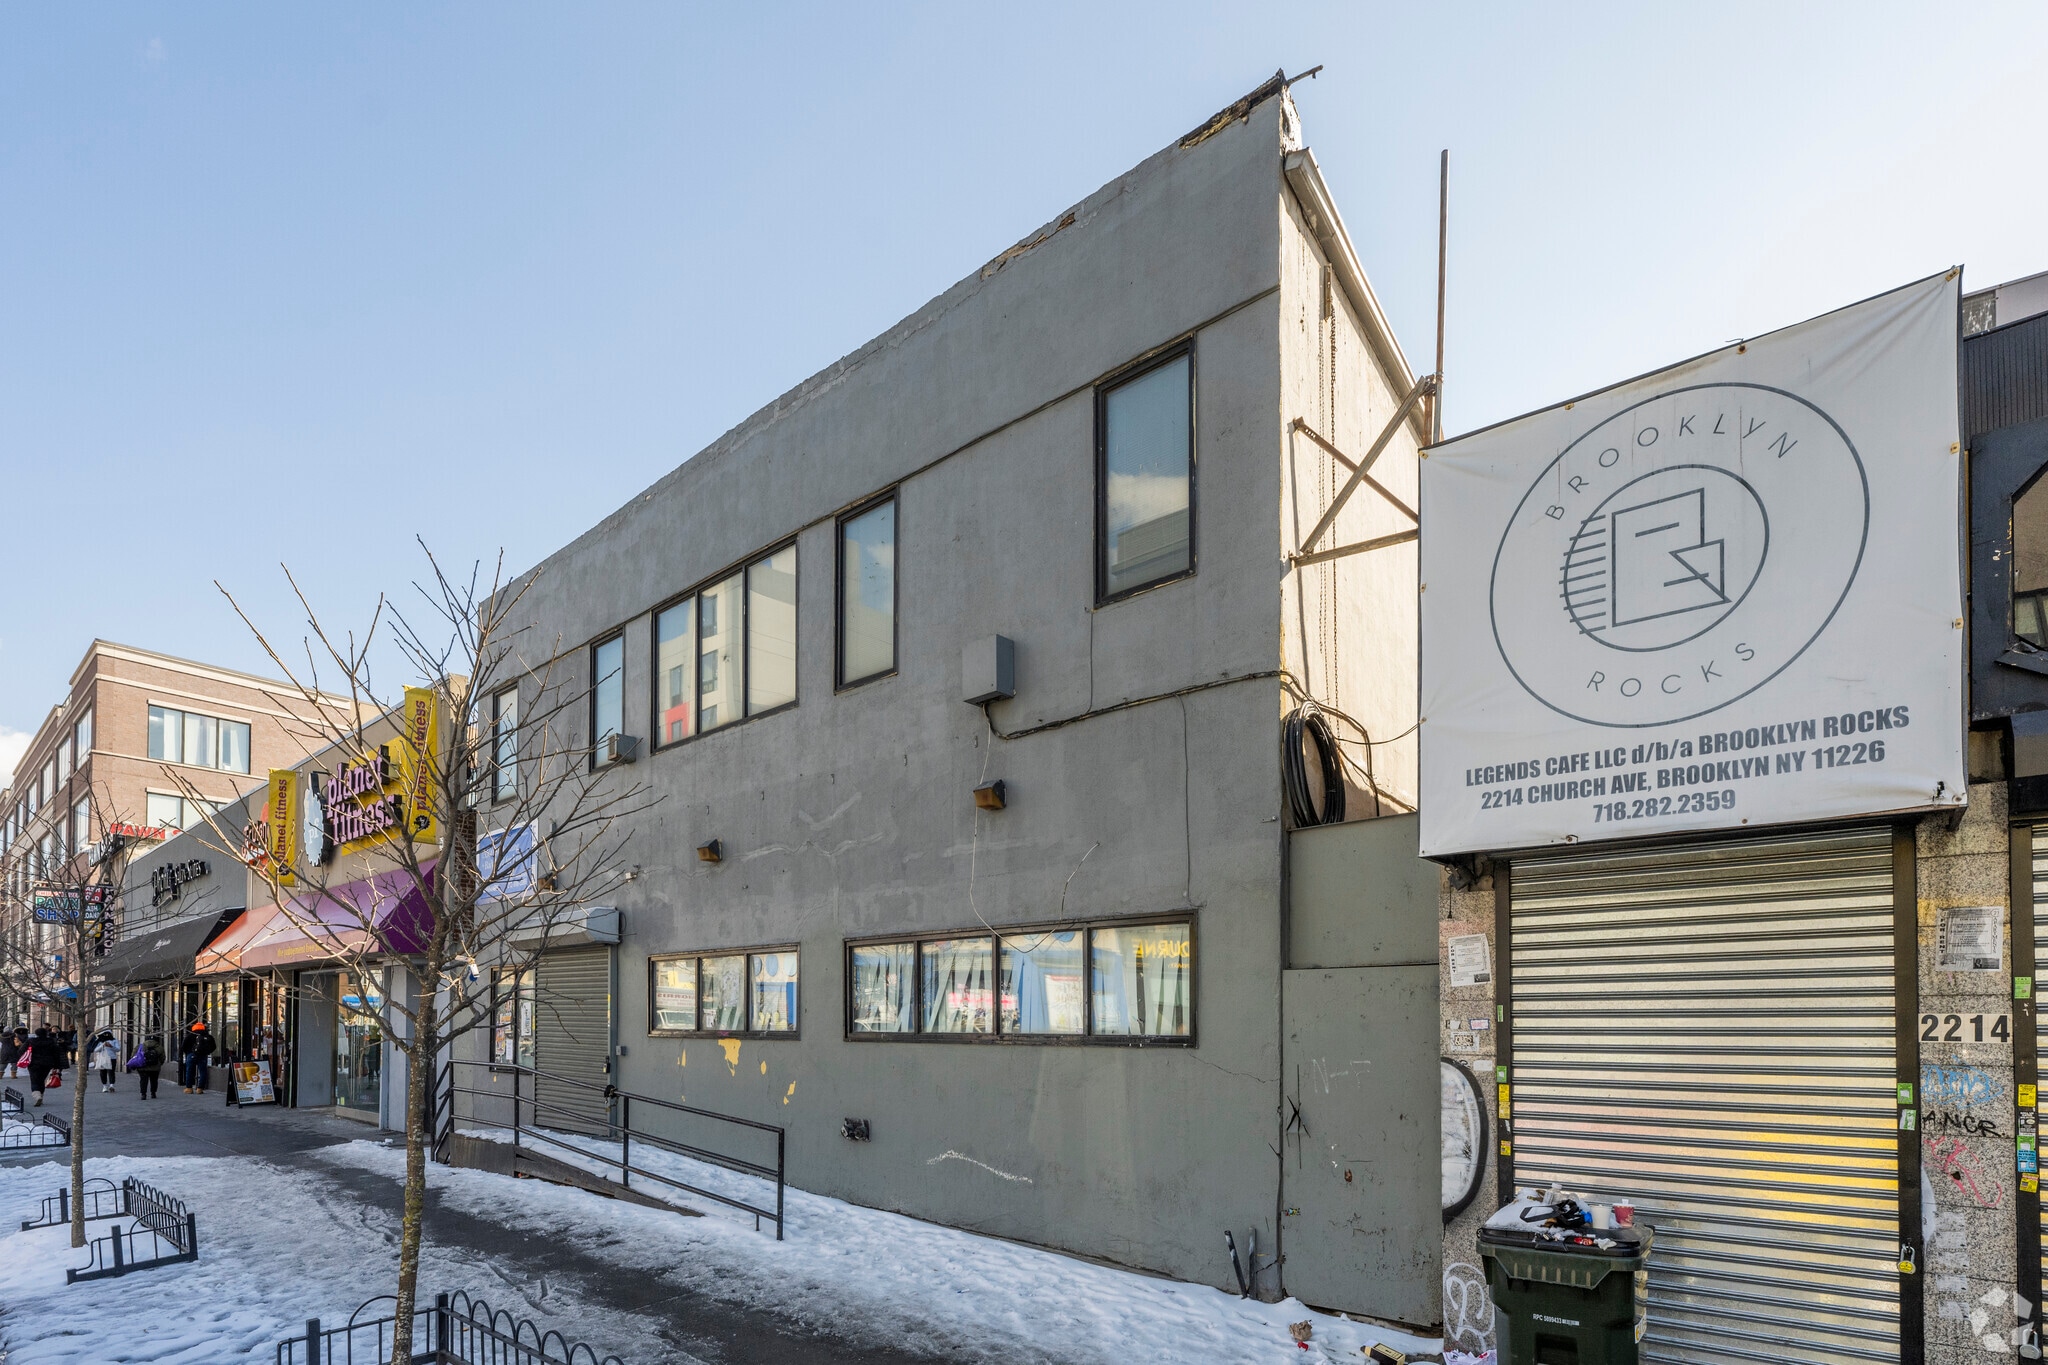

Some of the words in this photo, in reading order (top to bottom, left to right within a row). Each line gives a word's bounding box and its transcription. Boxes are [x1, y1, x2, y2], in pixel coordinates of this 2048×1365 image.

[1544, 413, 1799, 521] BROOKLYN
[1586, 642, 1755, 699] ROCKS
[1466, 761, 1541, 787] LEGENDS
[1545, 753, 1590, 776] CAFE
[1594, 747, 1627, 769] LLC
[1632, 737, 1693, 764] d/b/a
[1698, 719, 1816, 756] BROOKLYN
[1823, 705, 1910, 738] ROCKS
[327, 746, 382, 819] planet
[1481, 788, 1524, 810] 2214
[1527, 777, 1606, 804] CHURCH
[1610, 771, 1652, 799] AVE,
[1657, 755, 1770, 789] BROOKLYN
[1776, 750, 1806, 775] NY
[1811, 739, 1885, 770] 11226
[275, 778, 288, 821] fitness
[333, 795, 395, 846] fitness
[1593, 789, 1736, 823] 718.282.2359
[110, 823, 166, 840] PAWN
[274, 823, 289, 864] planet
[35, 896, 81, 910] PAWN
[1920, 1014, 2011, 1042] 2214
